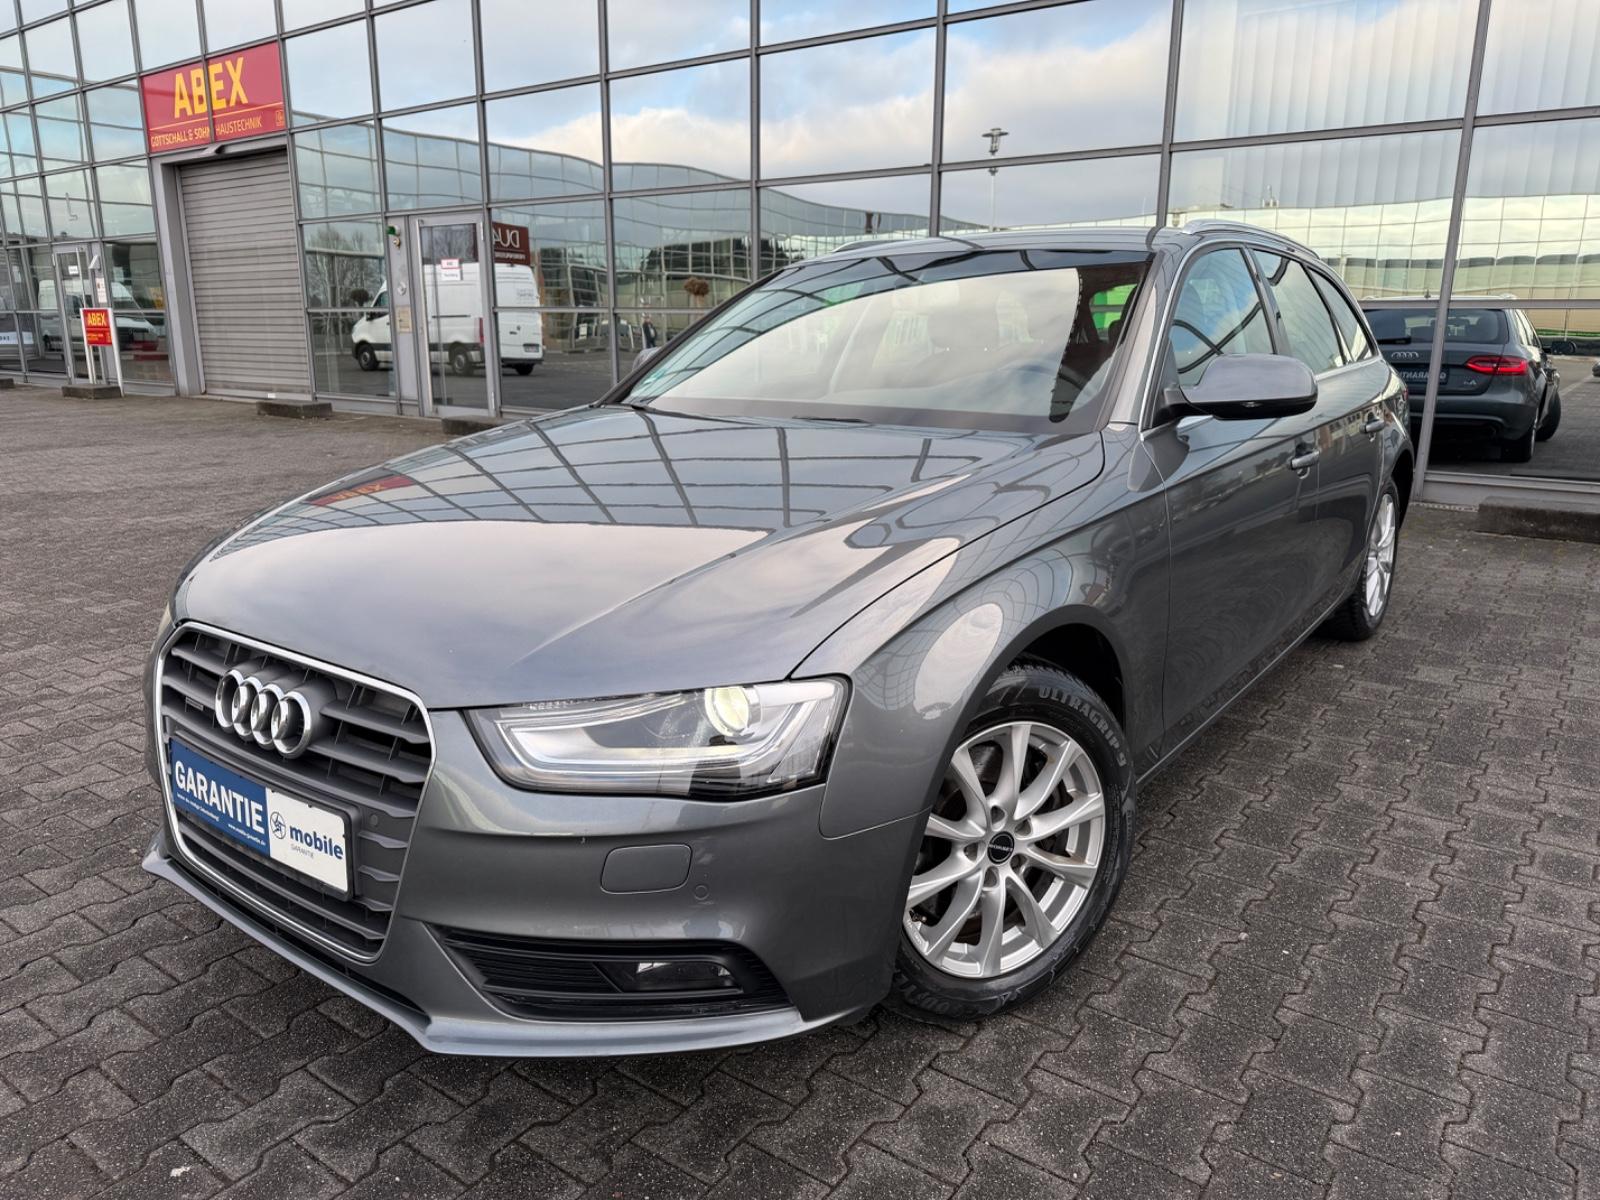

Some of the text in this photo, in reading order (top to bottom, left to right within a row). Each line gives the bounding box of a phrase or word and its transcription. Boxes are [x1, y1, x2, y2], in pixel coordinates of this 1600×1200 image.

[174, 57, 248, 118] ABEX
[151, 130, 188, 147] GOTTSCHALL
[215, 117, 262, 135] HAUSTECHNIK
[87, 311, 107, 326] ABEX
[1038, 687, 1119, 749] ULTRAGRIP
[174, 760, 265, 835] GARANTIE
[289, 824, 344, 860] mobile
